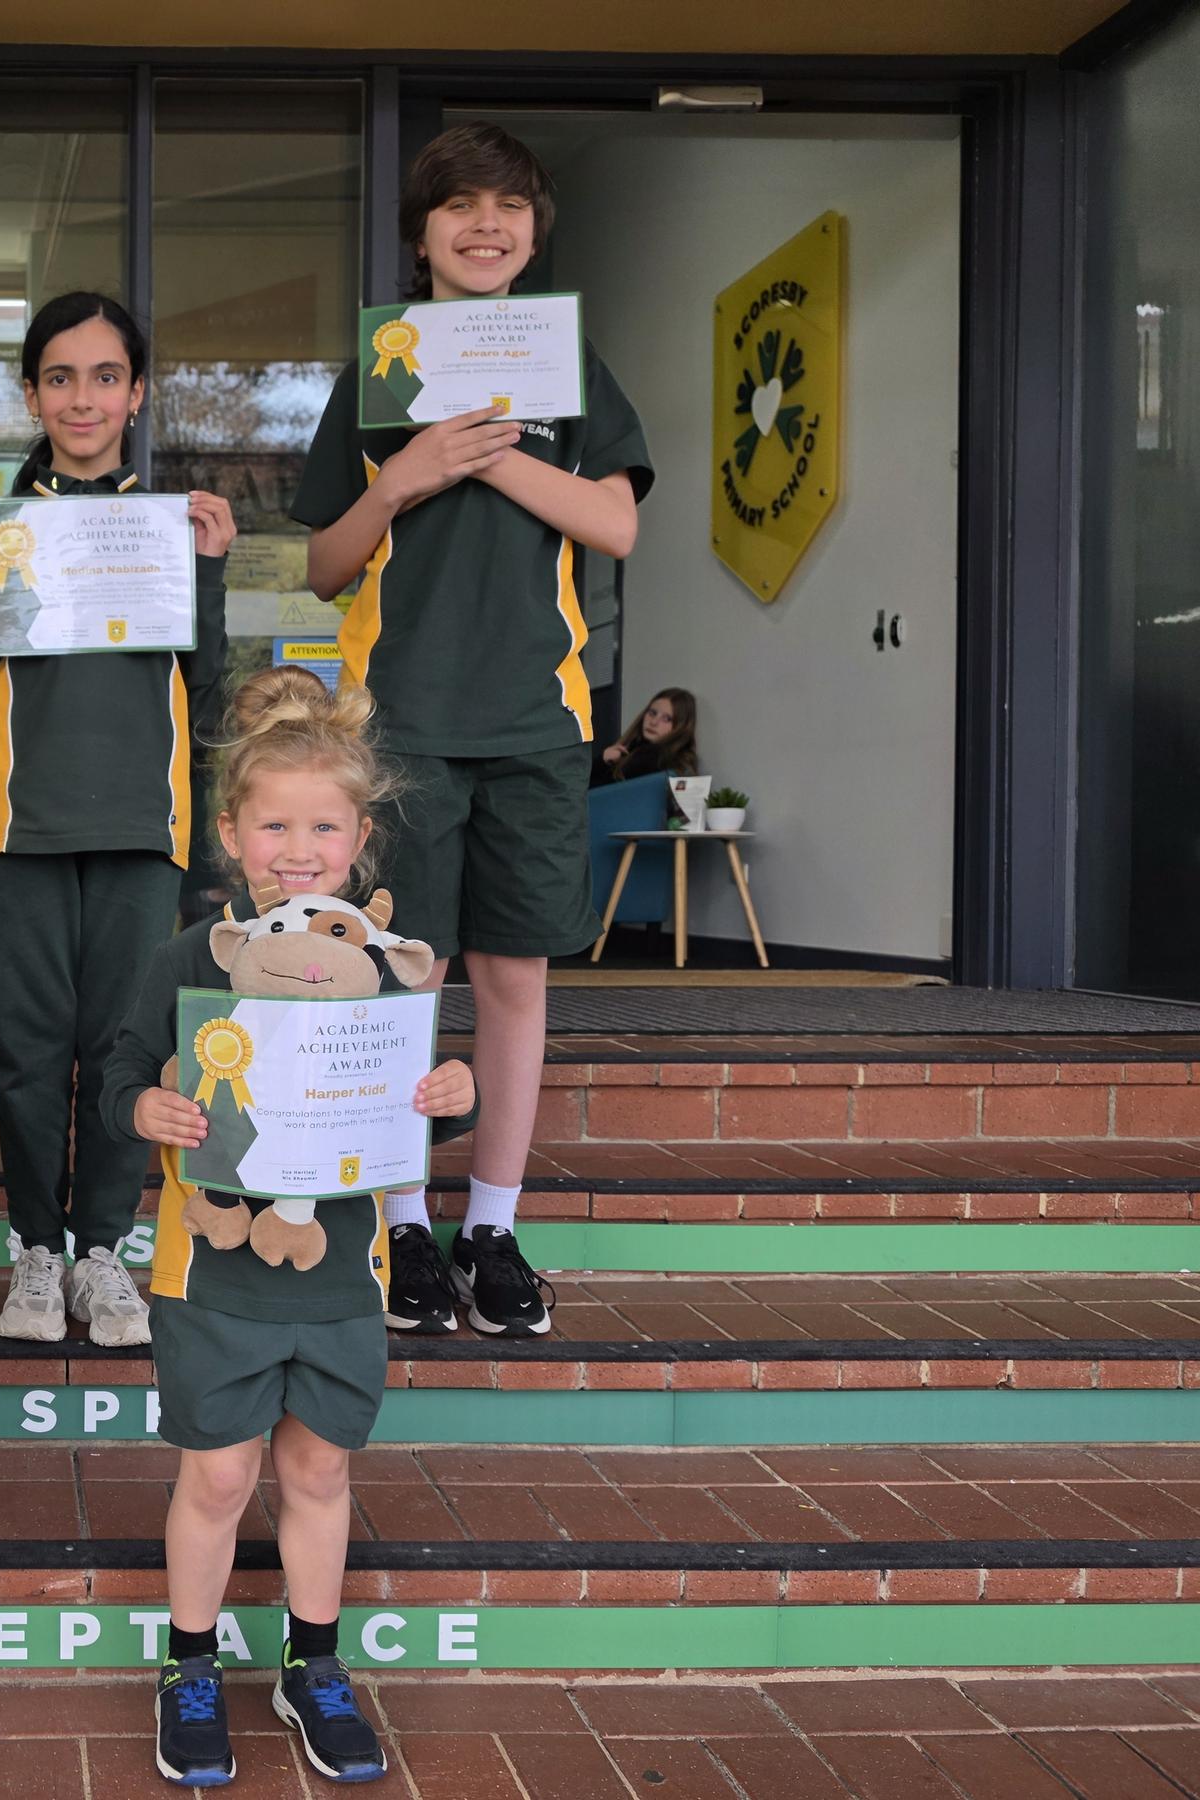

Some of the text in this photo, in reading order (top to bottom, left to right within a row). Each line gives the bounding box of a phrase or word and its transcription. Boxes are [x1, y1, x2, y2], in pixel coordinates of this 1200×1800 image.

[466, 312, 539, 322] ACADEMIC
[734, 281, 808, 350] SCORESBY
[452, 323, 552, 334] ACHIEVEMENT
[478, 335, 527, 344] AWARD
[460, 349, 532, 359] Alvaro Agar
[521, 422, 549, 438] YEAR
[721, 413, 820, 527] PRIMARY SCHOOL
[80, 516, 151, 527] ACADEMIC
[69, 529, 163, 541] ACHIEVEMENT
[92, 544, 140, 553] AWARD
[290, 647, 339, 655] ATTENTION
[315, 1021, 396, 1036] ACADEMIC
[296, 1037, 408, 1054] ACHIEVEMENT
[328, 1058, 383, 1072] AWARD
[304, 1084, 387, 1101] Harper Kidd
[256, 1107, 330, 1119] Congratulations
[333, 1109, 342, 1118] to
[344, 1107, 371, 1118] Harper
[373, 1105, 384, 1113] for
[284, 1115, 394, 1130] work and growth in writing
